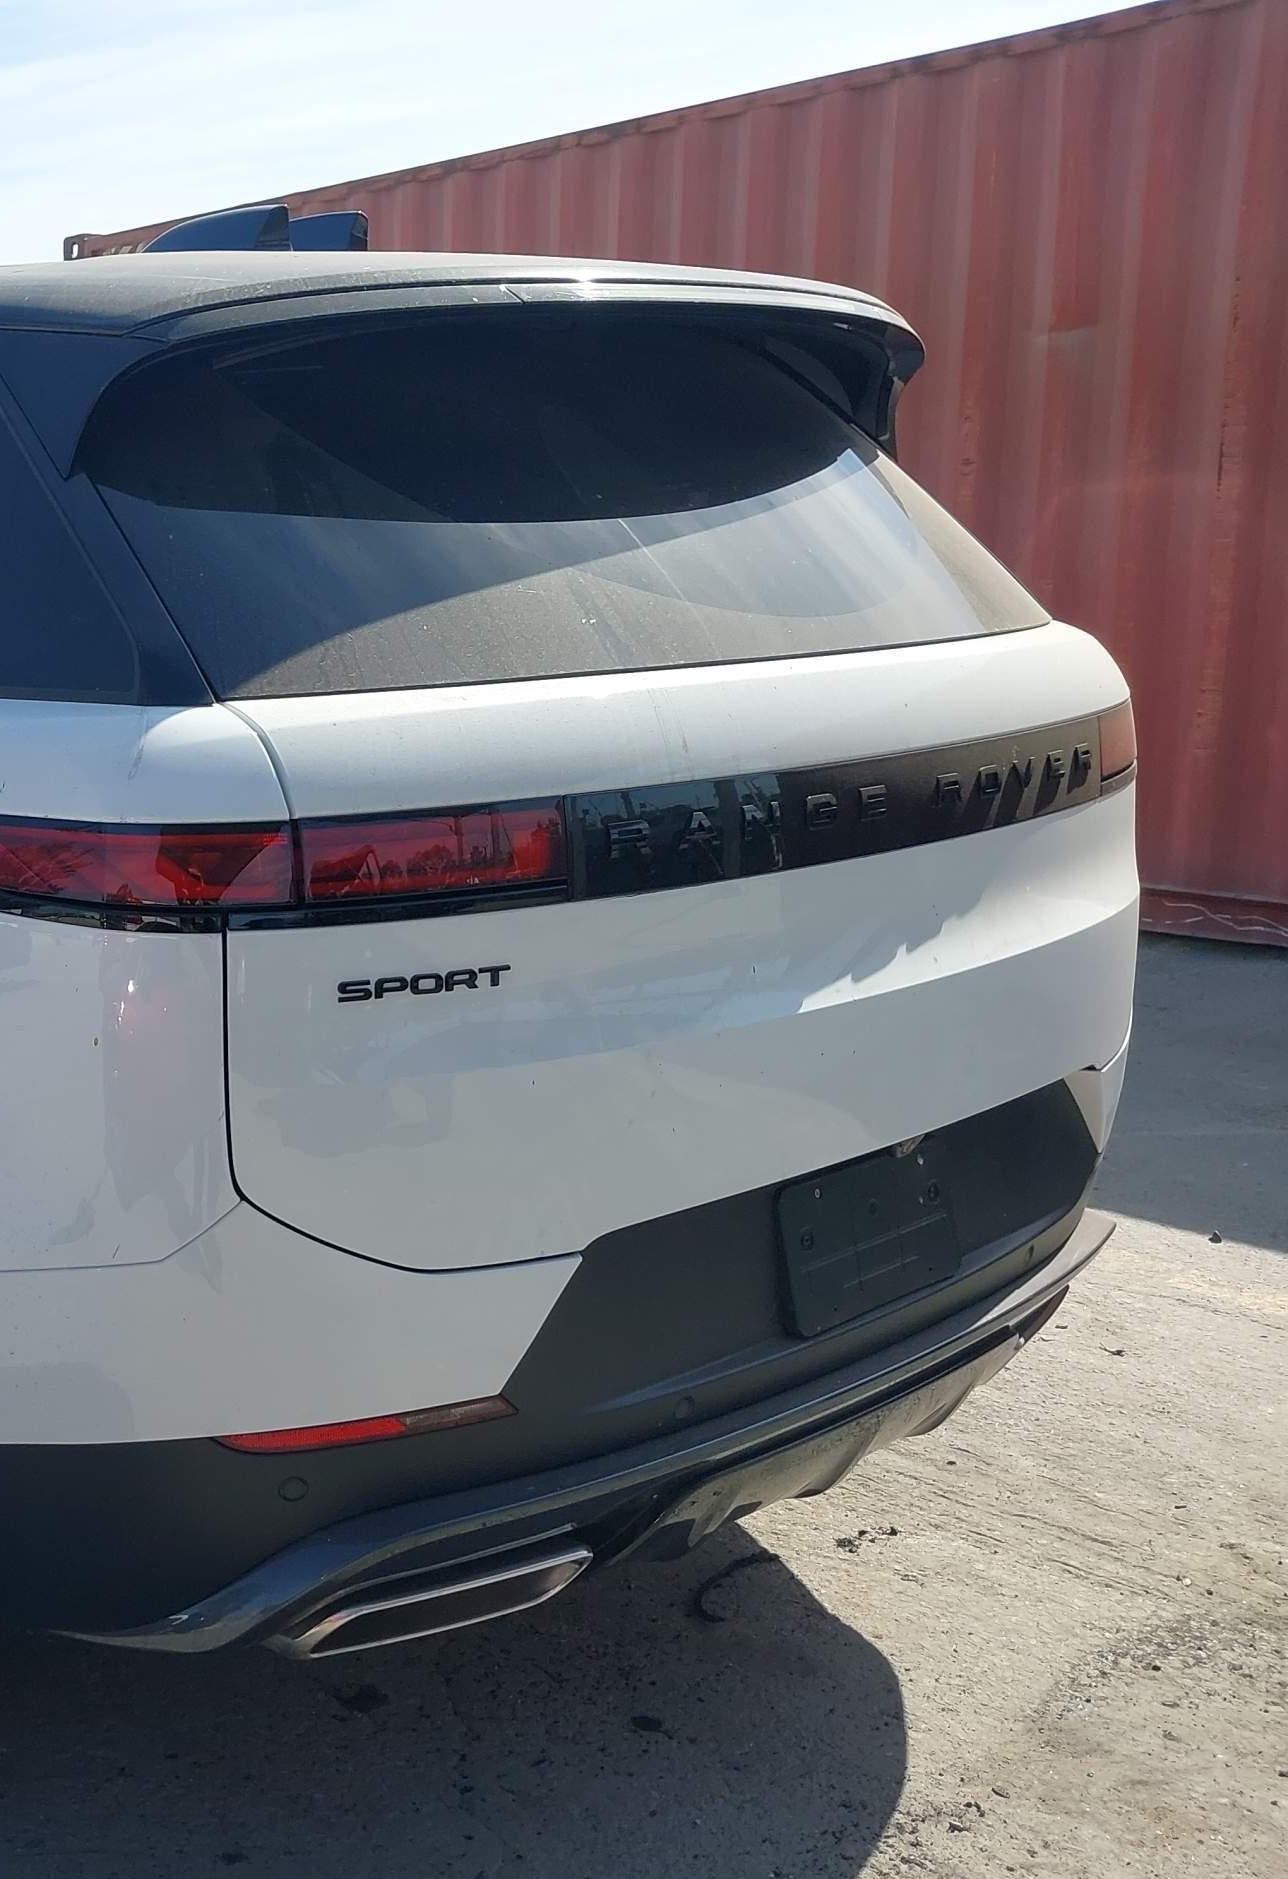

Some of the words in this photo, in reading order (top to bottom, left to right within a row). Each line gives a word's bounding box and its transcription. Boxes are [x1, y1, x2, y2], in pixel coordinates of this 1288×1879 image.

[607, 784, 887, 858] RANGE
[933, 743, 1092, 806] ROVER
[337, 964, 511, 1003] SPORT
